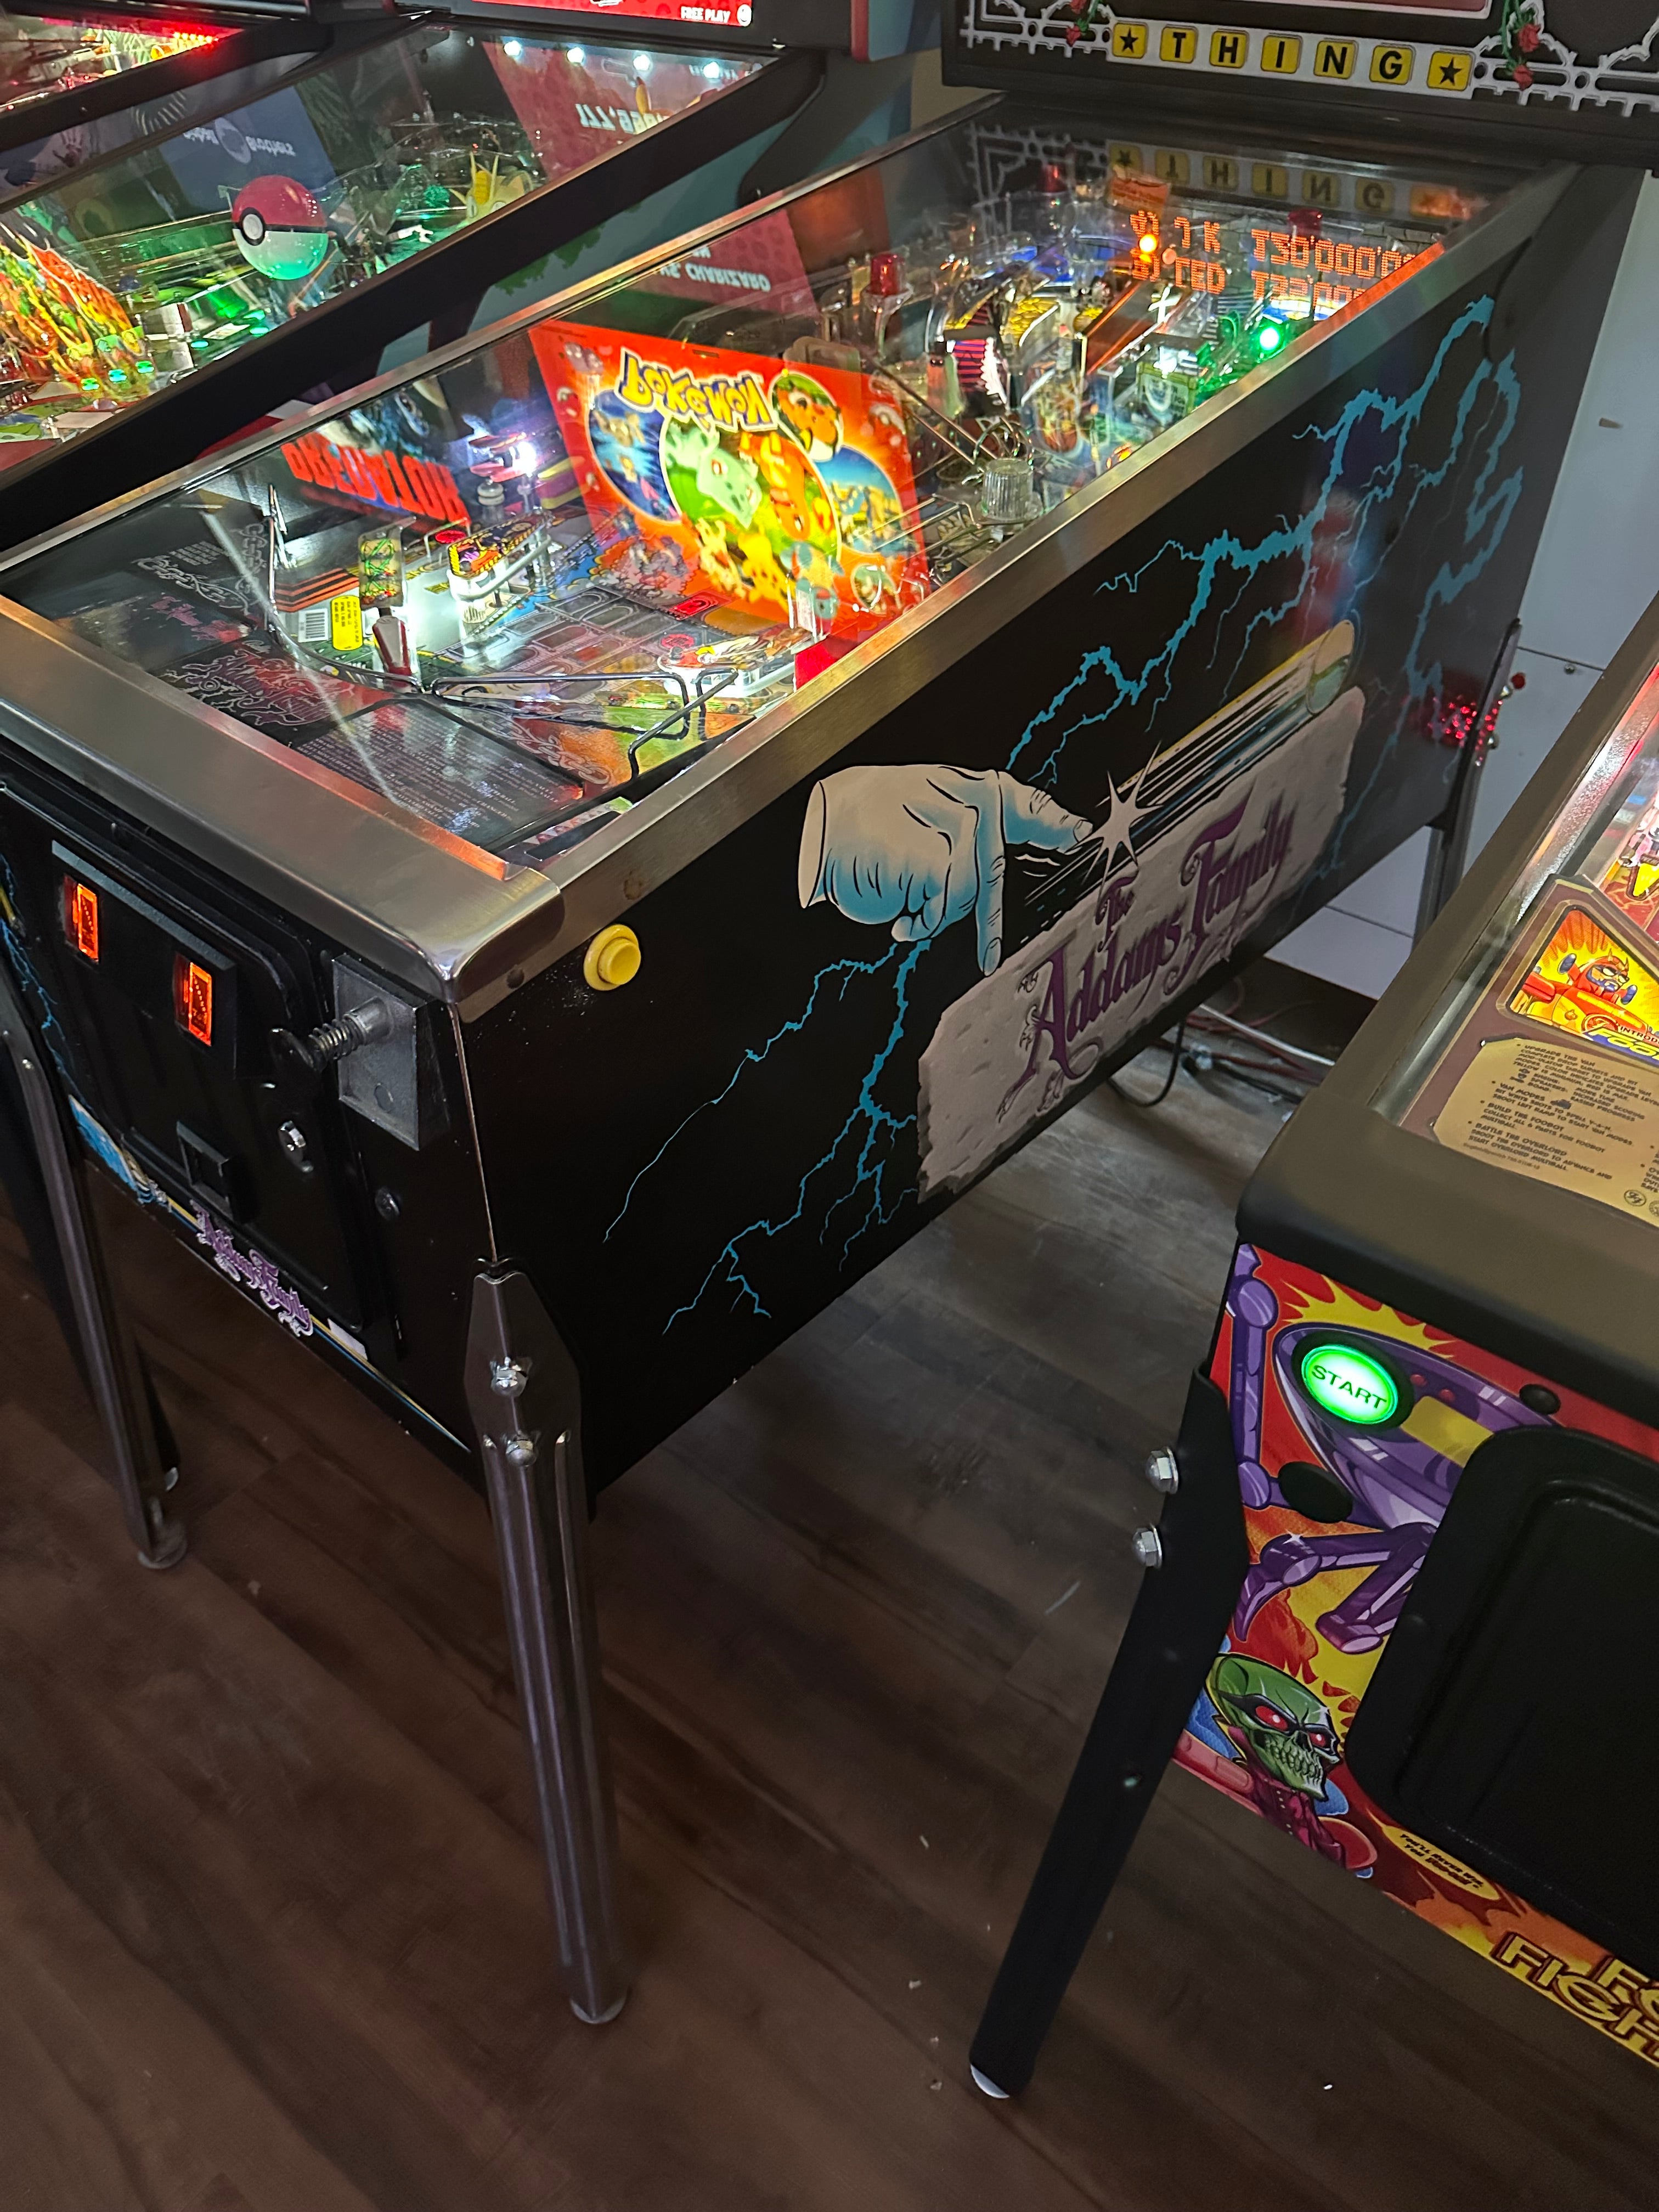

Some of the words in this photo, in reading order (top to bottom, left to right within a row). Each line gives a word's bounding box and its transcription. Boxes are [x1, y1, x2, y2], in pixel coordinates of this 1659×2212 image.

[681, 6, 703, 21] FREE
[705, 9, 731, 23] PLAY
[1173, 32, 1403, 80] THING
[1095, 876, 1138, 952] The
[998, 908, 1184, 1119] Addams
[1164, 795, 1296, 996] Family
[1587, 1026, 1659, 1062] FOO
[1619, 1026, 1659, 1044] INTROD
[1521, 1049, 1555, 1060] COMPLETE
[1581, 1065, 1609, 1076] TARGETS
[1525, 1045, 1561, 1056] UPGRADE
[1513, 1061, 1539, 1070] YELLOW
[1566, 1066, 1589, 1076] TARGET
[1604, 1077, 1636, 1091] UPGRADE
[1515, 1089, 1545, 1101] MODES
[1545, 1065, 1568, 1074] COLOR
[1570, 1073, 1604, 1086] INDICATES
[1607, 1084, 1639, 1098] UPGRADE
[1575, 1087, 1596, 1096] MORE
[1600, 1094, 1615, 1103] TIME
[1487, 1102, 1511, 1113] BUILD
[1514, 1111, 1528, 1119] THE
[1531, 1117, 1564, 1131] FOOBOT
[1493, 1093, 1515, 1104] SHOOT
[1534, 1107, 1555, 1116] RAMP
[1568, 1119, 1589, 1129] START
[1531, 1099, 1552, 1109] SHOTS
[1566, 1112, 1585, 1122] SPELL
[1570, 1097, 1595, 1107] EASIER
[1597, 1105, 1635, 1121] PROGRESS
[1573, 1092, 1611, 1106] INCREASED
[1614, 1105, 1645, 1119] SCORING
[1475, 1123, 1503, 1135] BATTLE
[1506, 1132, 1520, 1141] THE
[1522, 1138, 1567, 1156] OVERLORD
[1483, 1109, 1513, 1120] COLLECT
[1535, 1125, 1557, 1136] PARTS
[1576, 1139, 1606, 1153] FOOBOT
[1468, 1135, 1489, 1144] START
[1491, 1142, 1530, 1157] OVERLORD
[1471, 1129, 1494, 1139] SHOOT
[1510, 1142, 1549, 1157] OVERLORD
[1563, 1160, 1595, 1173] ADVANCE
[1312, 1365, 1387, 1409] START
